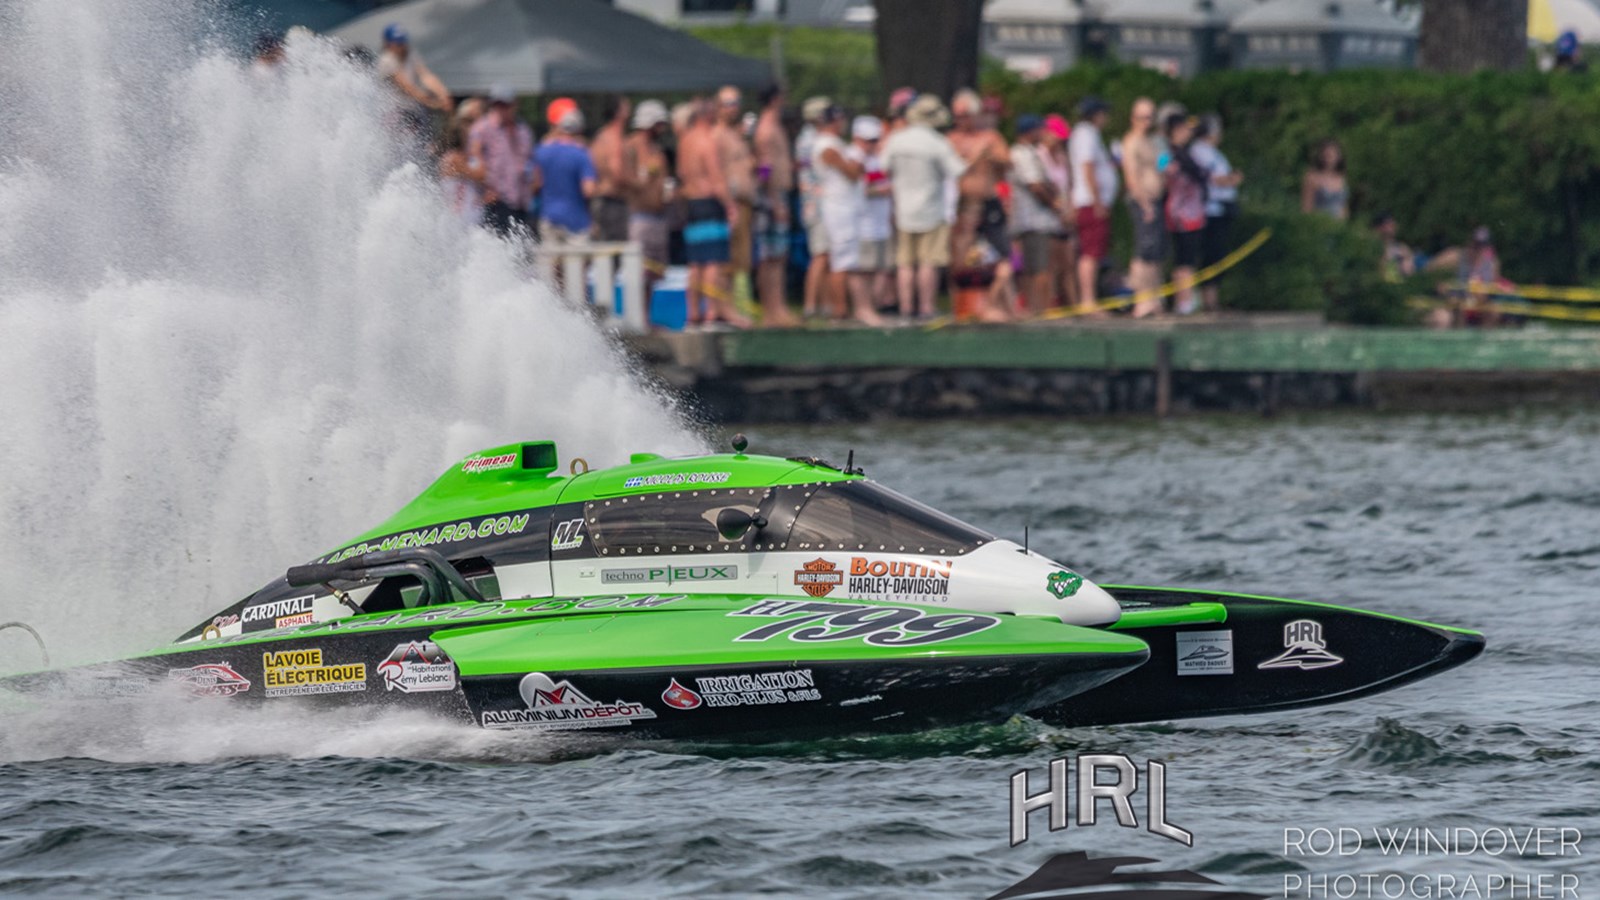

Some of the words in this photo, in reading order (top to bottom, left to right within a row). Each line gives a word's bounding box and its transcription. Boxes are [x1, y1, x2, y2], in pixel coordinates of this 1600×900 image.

[606, 571, 644, 580] techno
[850, 557, 952, 579] BOUTIN
[849, 578, 949, 595] HARLEY-DAVIDSON
[848, 594, 948, 602] VALLEYFIELD
[242, 598, 313, 623] CARDINAL
[278, 614, 313, 628] ASPHALTE
[1285, 620, 1325, 649] HRL
[265, 652, 320, 668] LAVOIE
[266, 666, 364, 685] ÉLECTRIQUE
[412, 665, 452, 673] Habitations
[419, 674, 448, 684] Leblanc
[695, 669, 814, 693] IRRIGATION
[702, 690, 787, 707] PRO-PLUS
